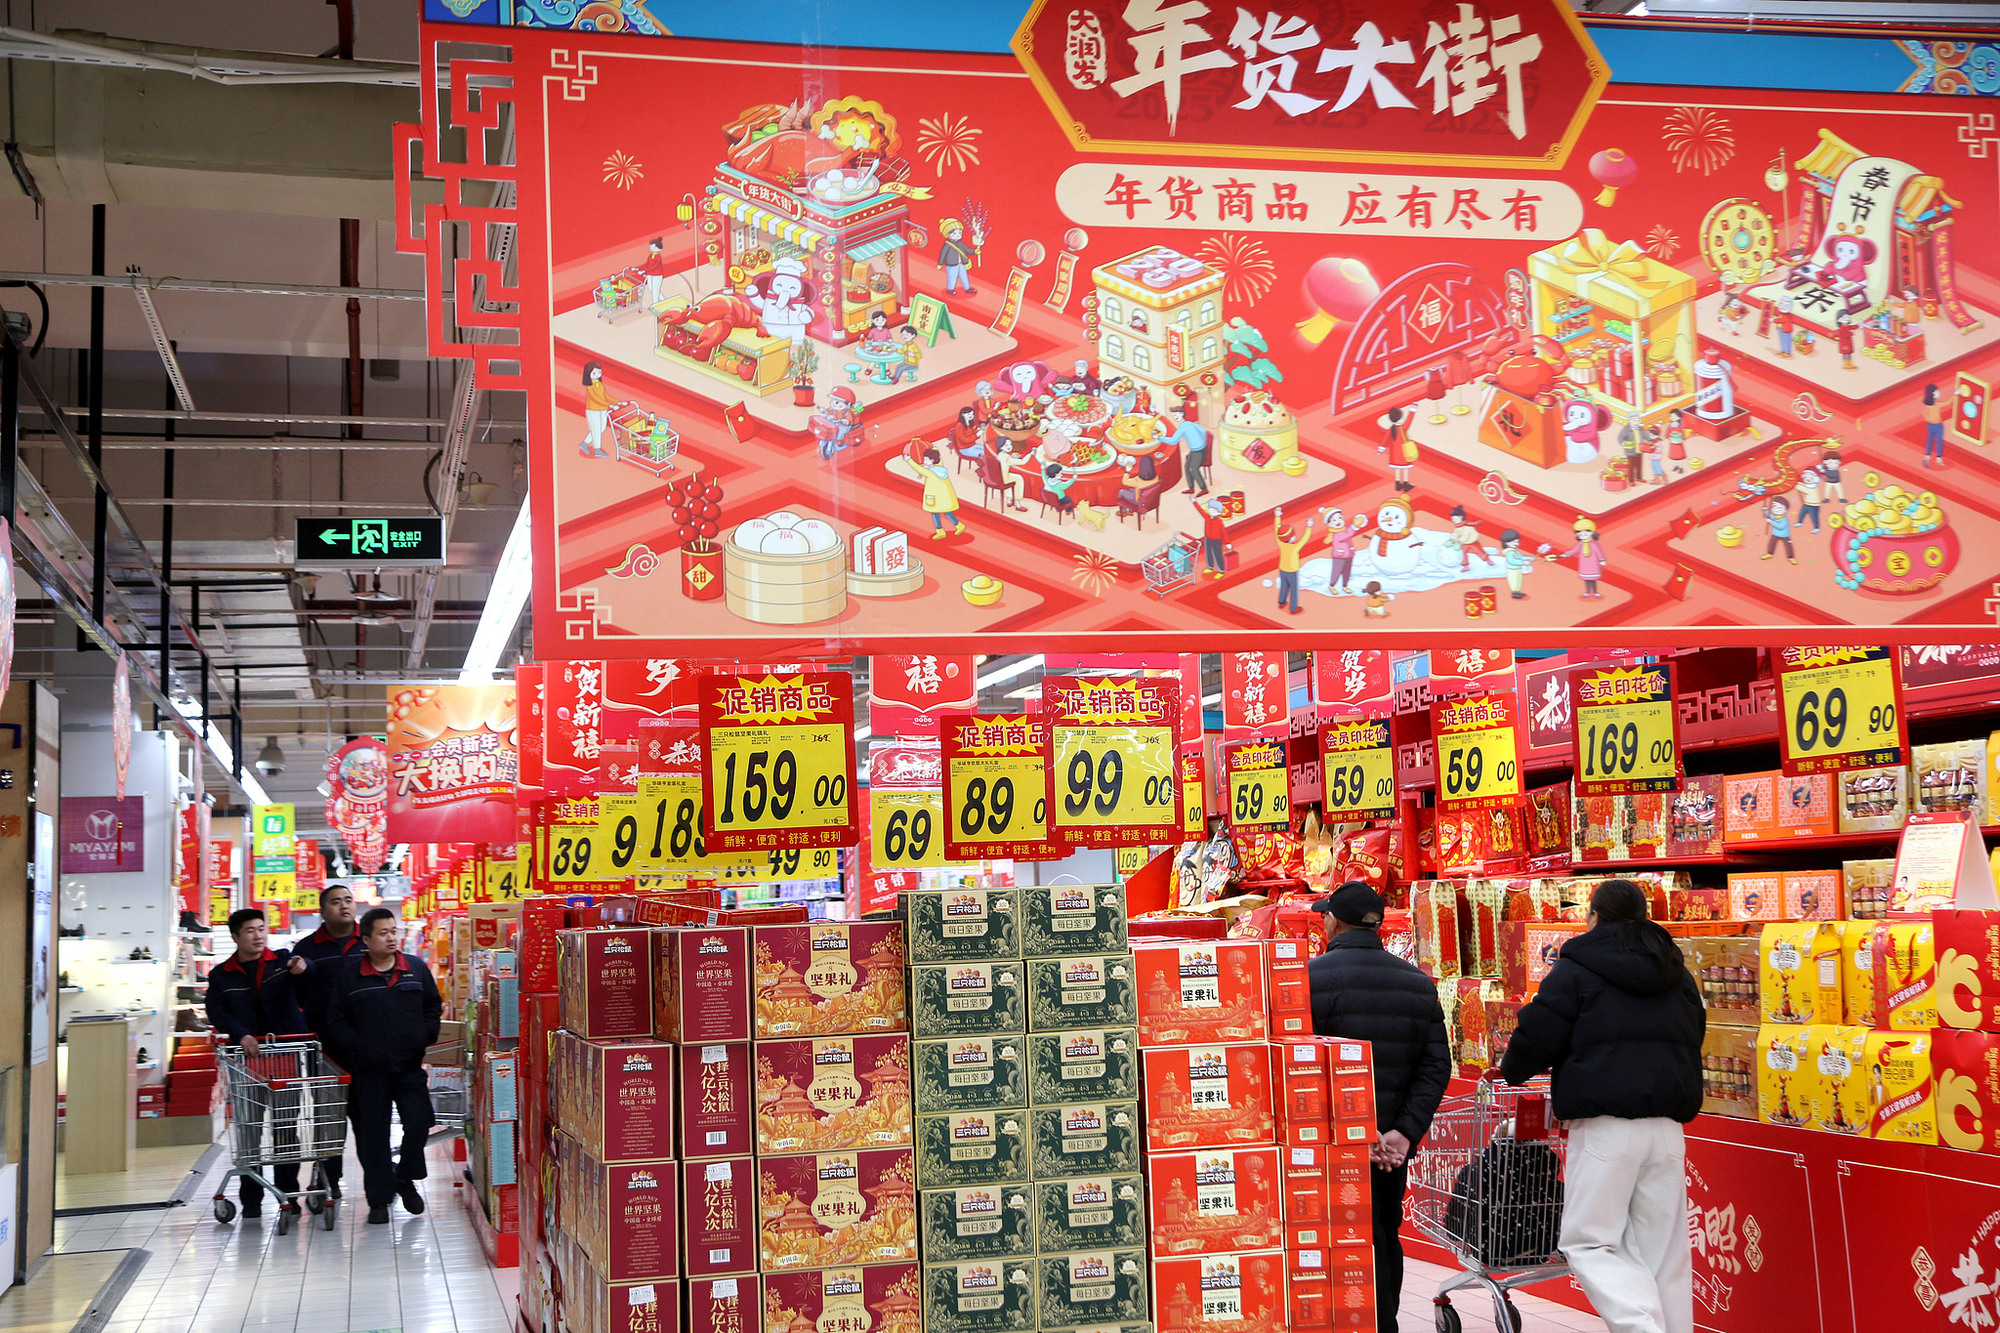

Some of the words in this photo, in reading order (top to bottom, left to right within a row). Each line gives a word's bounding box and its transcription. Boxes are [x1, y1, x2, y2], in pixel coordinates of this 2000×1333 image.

[1067, 9, 1102, 89] 大润发
[1111, 0, 1543, 139] 年货大街
[748, 184, 792, 212] 年货大街
[1850, 167, 1892, 223] 春节
[1104, 173, 1309, 222] 年货商品
[1340, 182, 1543, 231] 应有尽有
[1419, 297, 1443, 329] 福
[389, 531, 422, 542] 安全出口
[692, 569, 707, 583] 甜
[1456, 650, 1488, 674] 禧
[904, 655, 944, 696] 禧
[1579, 673, 1666, 701] 会员印花价
[721, 682, 832, 716] 促销商品
[1064, 688, 1163, 715] 促销商品
[1442, 701, 1507, 727] 促销商品
[1796, 687, 1896, 752] 69.90
[960, 725, 1045, 749] 促销商品
[1325, 727, 1390, 750] 会员印花价
[431, 733, 499, 757] 会员新年
[1585, 721, 1673, 776] 169.00
[1230, 747, 1284, 768] 会员印花价
[394, 753, 497, 797] 大换购
[1446, 745, 1516, 795] 59.00
[720, 749, 846, 824] 159.00
[1064, 749, 1173, 817] 99.00
[1331, 764, 1393, 808] 59.00
[1235, 782, 1288, 821] 59.90
[724, 830, 841, 848] 新鲜·便宜·舒适·便利
[1064, 829, 1169, 841] 新鲜·便宜·舒适·便利
[70, 842, 136, 854] MIYAYAMI
[1121, 851, 1139, 868] 109
[874, 873, 906, 894] 促销
[948, 905, 981, 914] 三只松鼠
[1057, 899, 1090, 909] 三只松鼠
[948, 924, 983, 935] 每日坚果
[1057, 918, 1092, 928] 每日坚果
[604, 945, 633, 954] 三只松鼠
[698, 945, 729, 954] 三只松鼠
[813, 940, 848, 949] 三只松鼠
[601, 968, 637, 978] 世界坚果
[696, 969, 733, 980] 世界坚果
[1066, 971, 1099, 981] 三只松鼠
[1179, 965, 1219, 976] 三只松鼠
[810, 972, 852, 987] 坚果礼
[952, 979, 986, 988] 三只松鼠
[1067, 991, 1102, 1001] 每日坚果
[1183, 988, 1218, 1002] 坚果礼
[952, 998, 988, 1008] 每日坚果
[1066, 1046, 1099, 1056] 三只松鼠
[815, 1055, 851, 1064] 三只松鼠
[954, 1053, 987, 1063] 三只松鼠
[622, 1063, 653, 1072] 三只松鼠
[1067, 1065, 1102, 1076] 每日坚果
[1189, 1066, 1229, 1078] 三只松鼠
[717, 1054, 731, 1113] 择三只松鼠
[954, 1072, 990, 1083] 每日坚果
[701, 1056, 717, 1113] 八亿人次
[619, 1087, 657, 1098] 世界坚果
[813, 1086, 856, 1101] 坚果礼
[1192, 1090, 1227, 1104] 坚果礼
[1067, 1120, 1100, 1130] 三只松鼠
[955, 1128, 989, 1138] 三只松鼠
[1067, 1139, 1103, 1150] 每日坚果
[955, 1147, 992, 1158] 每日坚果
[820, 1168, 856, 1179] 三只松鼠
[1196, 1171, 1236, 1184] 三只松鼠
[628, 1180, 658, 1189] 三只松鼠
[704, 1171, 720, 1231] 八亿人次
[720, 1169, 734, 1230] 择三只松鼠
[1073, 1194, 1107, 1204] 三只松鼠
[1199, 1195, 1234, 1210] 坚果礼
[624, 1203, 662, 1216] 世界坚果
[817, 1201, 861, 1217] 坚果礼
[962, 1202, 995, 1212] 三只松鼠
[1074, 1213, 1110, 1224] 每日坚果
[962, 1221, 998, 1232] 每日坚果
[1075, 1268, 1109, 1278] 三只松鼠
[825, 1282, 862, 1294] 三只松鼠
[963, 1277, 997, 1287] 三只松鼠
[1201, 1275, 1241, 1289] 三只松鼠
[1075, 1288, 1110, 1298] 每日坚果
[1939, 1247, 2000, 1333] 恭
[964, 1297, 999, 1308] 每日坚果
[1203, 1301, 1240, 1315] 坚果礼
[822, 1317, 866, 1333] 坚果礼
